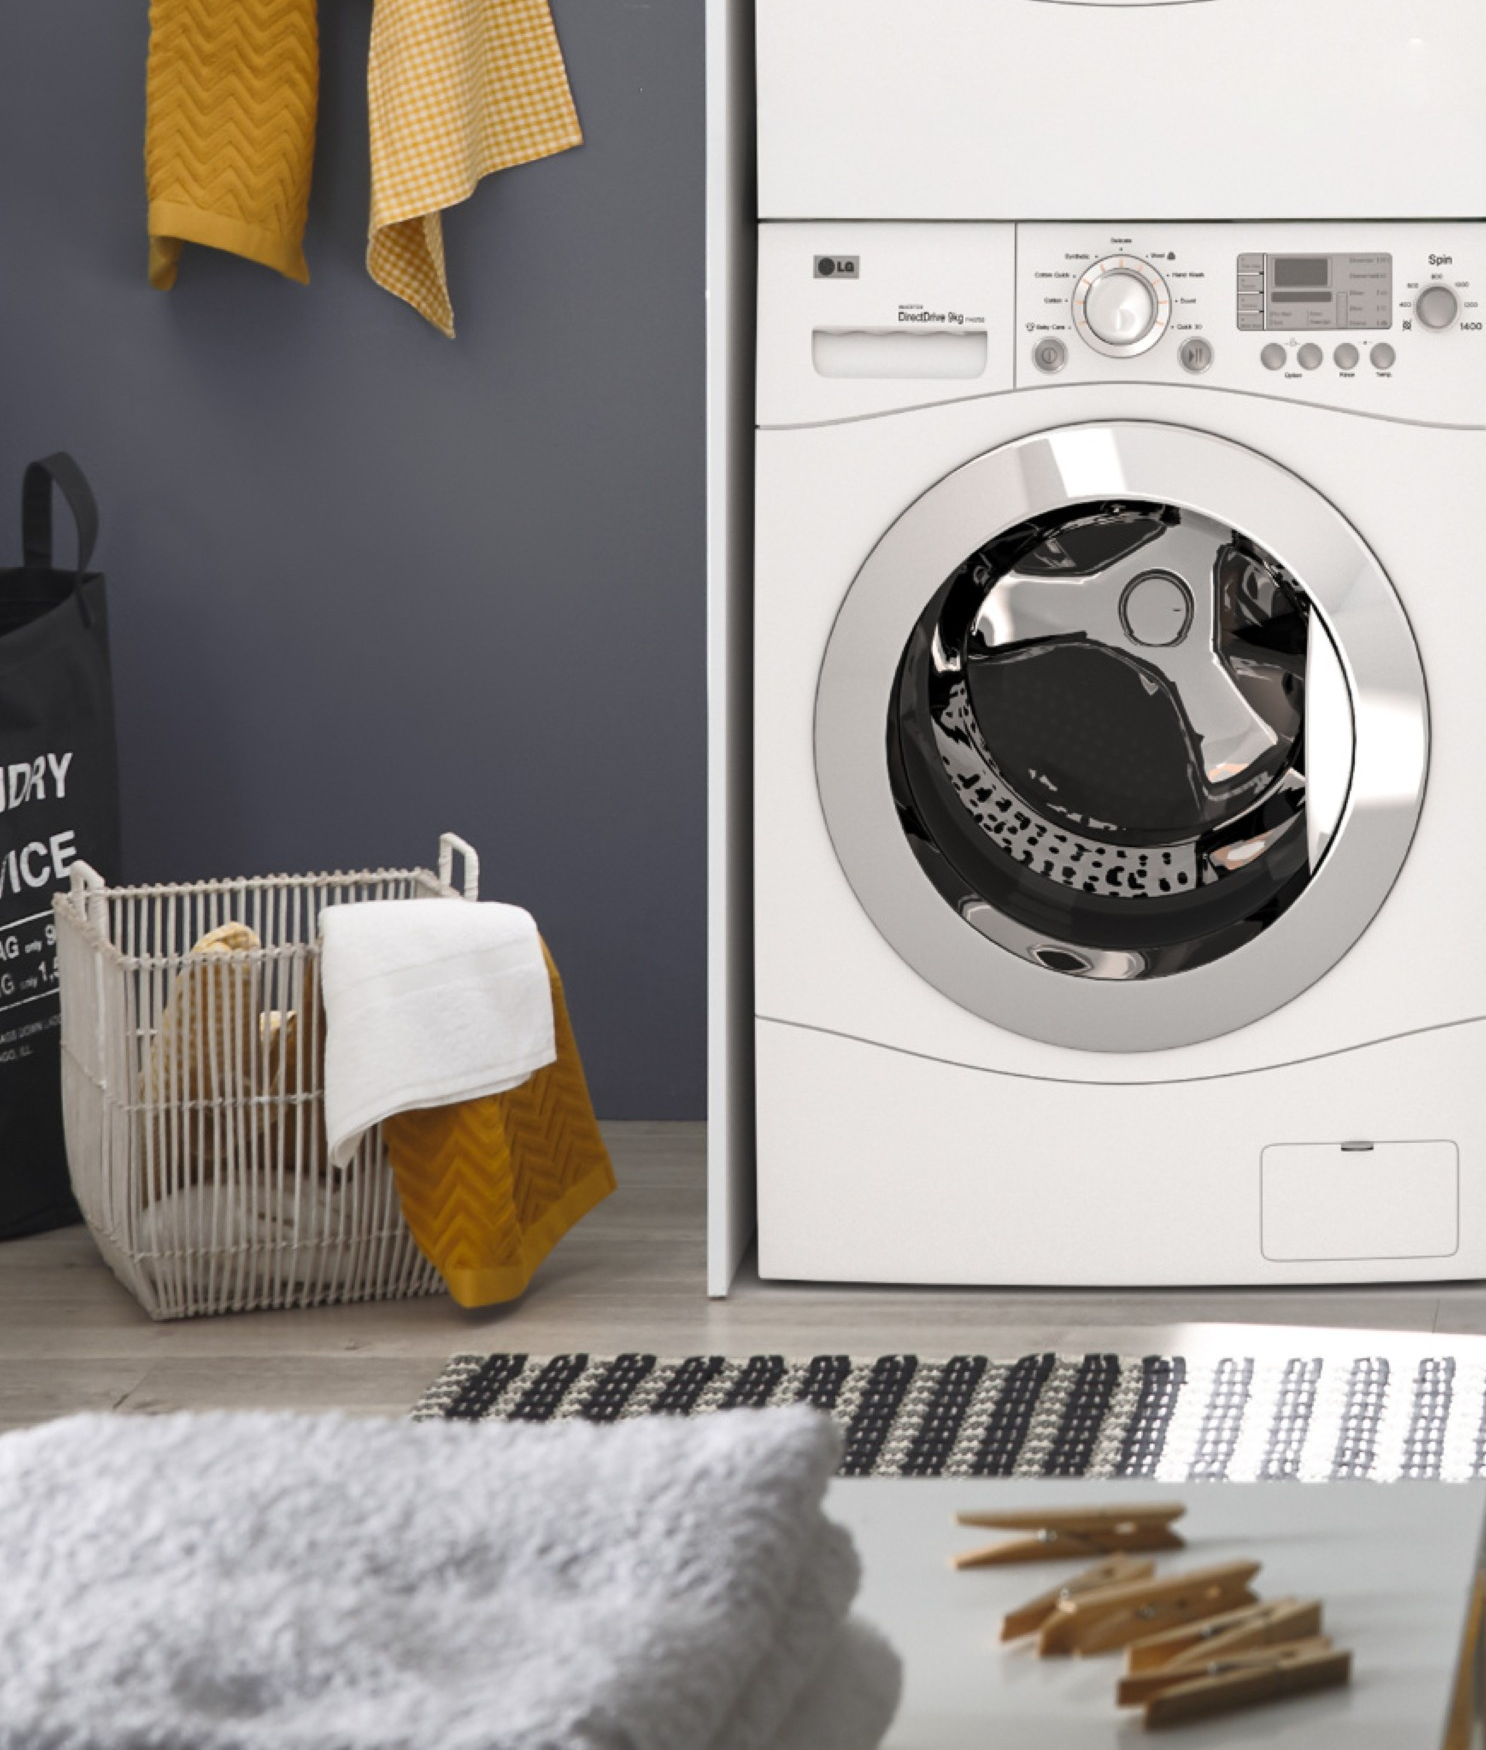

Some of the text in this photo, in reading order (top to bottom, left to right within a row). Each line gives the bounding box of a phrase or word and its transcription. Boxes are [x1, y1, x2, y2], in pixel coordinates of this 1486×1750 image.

[1428, 254, 1452, 266] Spin
[837, 261, 855, 272] LG
[1460, 322, 1482, 330] 1400
